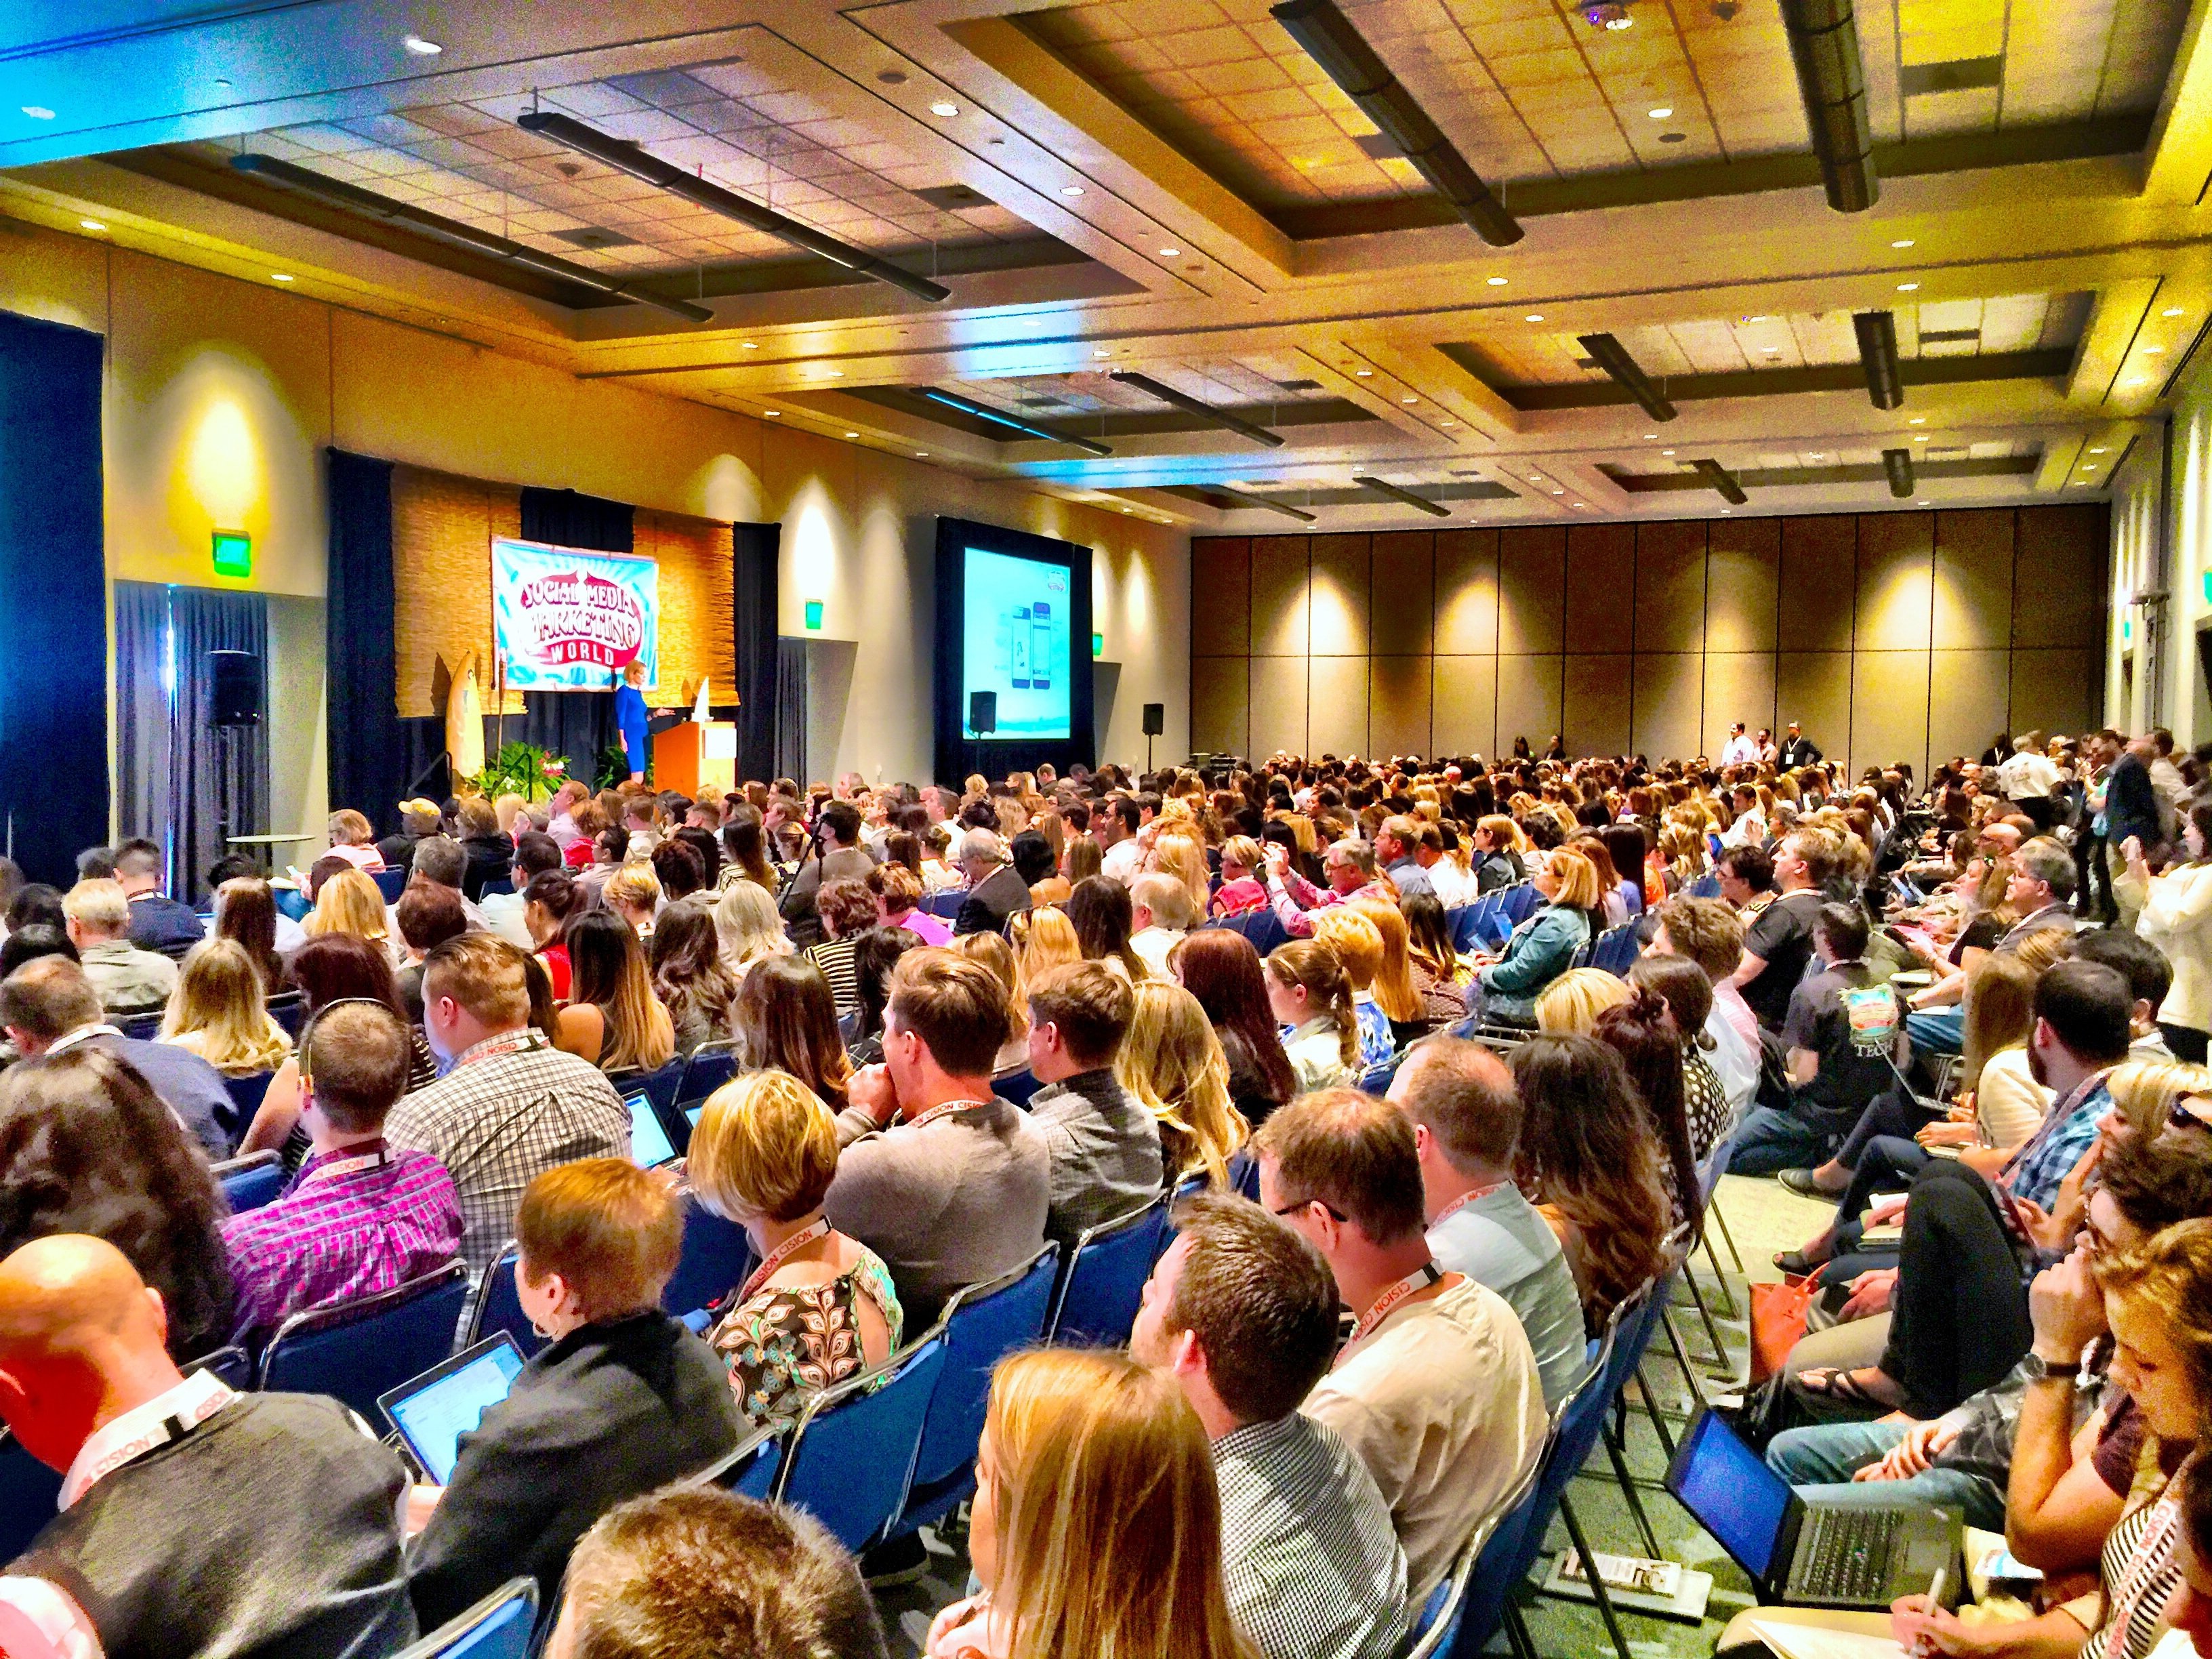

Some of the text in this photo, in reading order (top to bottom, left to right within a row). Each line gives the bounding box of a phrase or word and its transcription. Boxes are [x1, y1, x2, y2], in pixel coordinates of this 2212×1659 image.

[522, 579, 636, 618] SOCIAL MEDIA
[551, 642, 614, 665] WORLD
[487, 1042, 517, 1057] CISION
[926, 1103, 954, 1120] CISION
[327, 1159, 365, 1174] CISION
[779, 1229, 813, 1255] CISION
[1374, 1282, 1411, 1315] CISION
[193, 1388, 230, 1421] CISION
[92, 1435, 151, 1475] CISION
[2139, 1504, 2171, 1551] CISION
